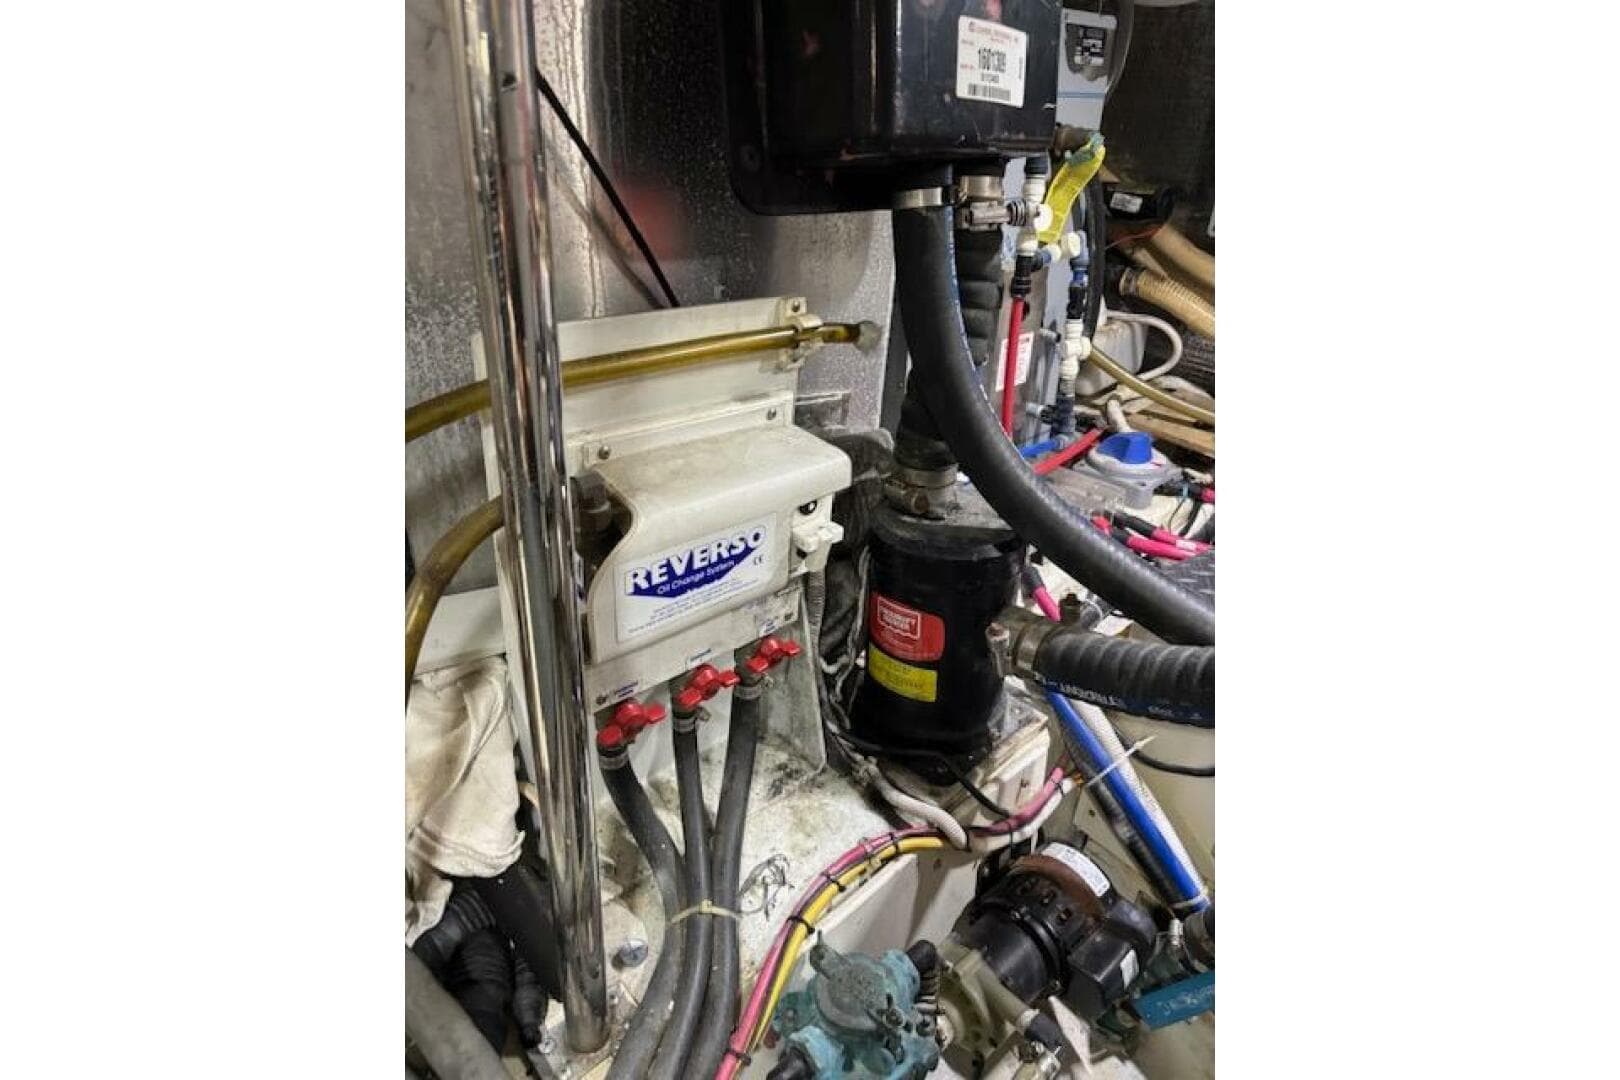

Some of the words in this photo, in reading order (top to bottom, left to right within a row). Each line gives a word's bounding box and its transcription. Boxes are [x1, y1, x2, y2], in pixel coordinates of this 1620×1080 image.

[626, 525, 766, 595] REVERSO
[657, 583, 671, 596] Oil
[672, 573, 706, 590] Change
[706, 560, 737, 577] System
